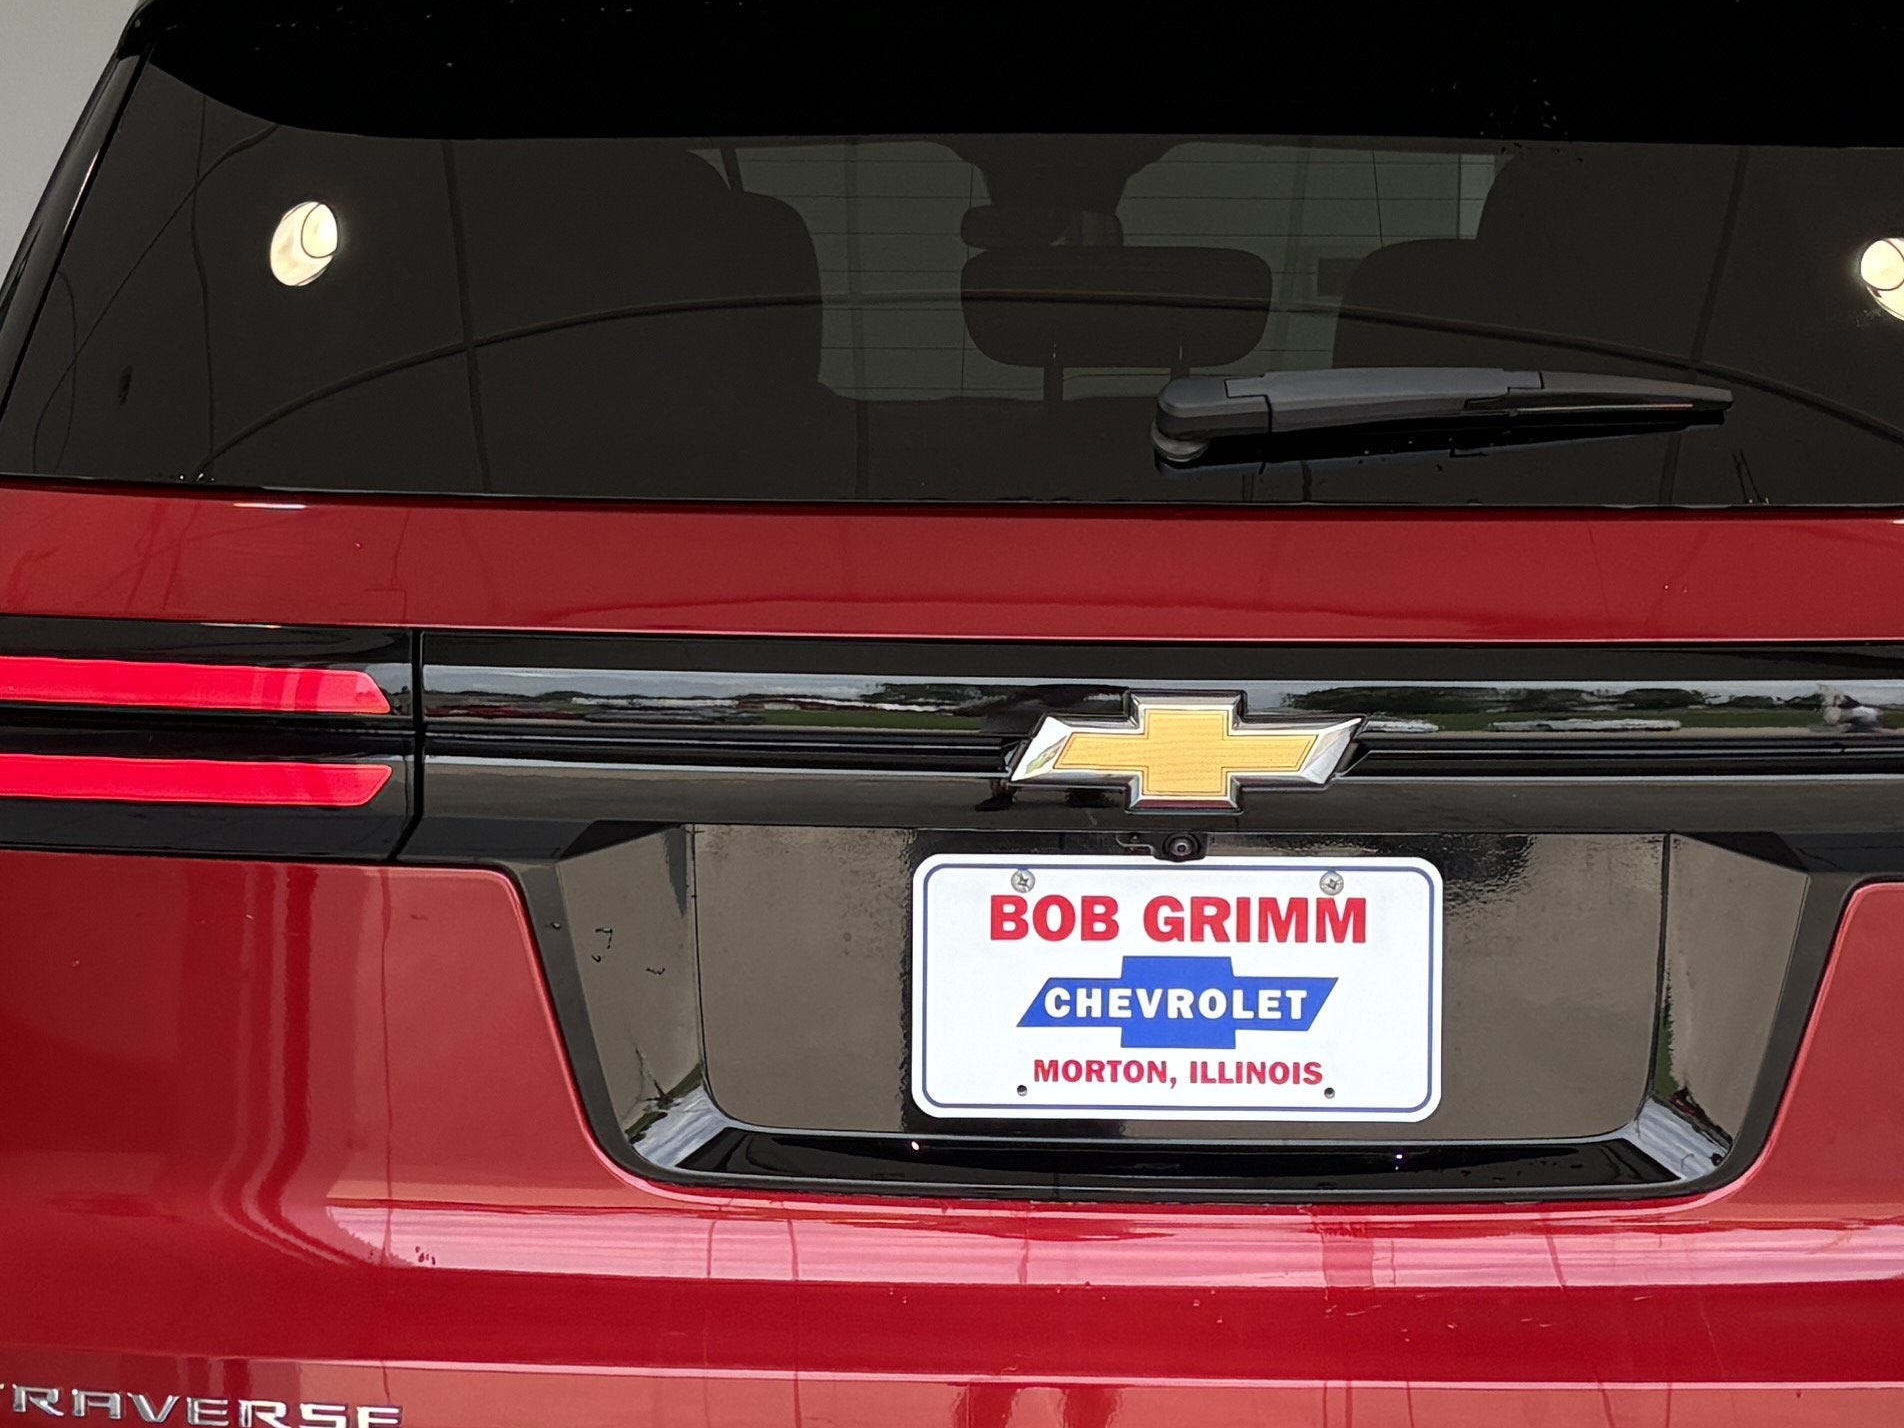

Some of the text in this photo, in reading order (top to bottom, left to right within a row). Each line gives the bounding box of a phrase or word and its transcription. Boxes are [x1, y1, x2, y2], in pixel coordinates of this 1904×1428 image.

[990, 895, 1366, 944] BOB GRIMM
[1044, 986, 1307, 1020] CHEVROLET
[1034, 1060, 1323, 1089] MORTON, ILLINOIS
